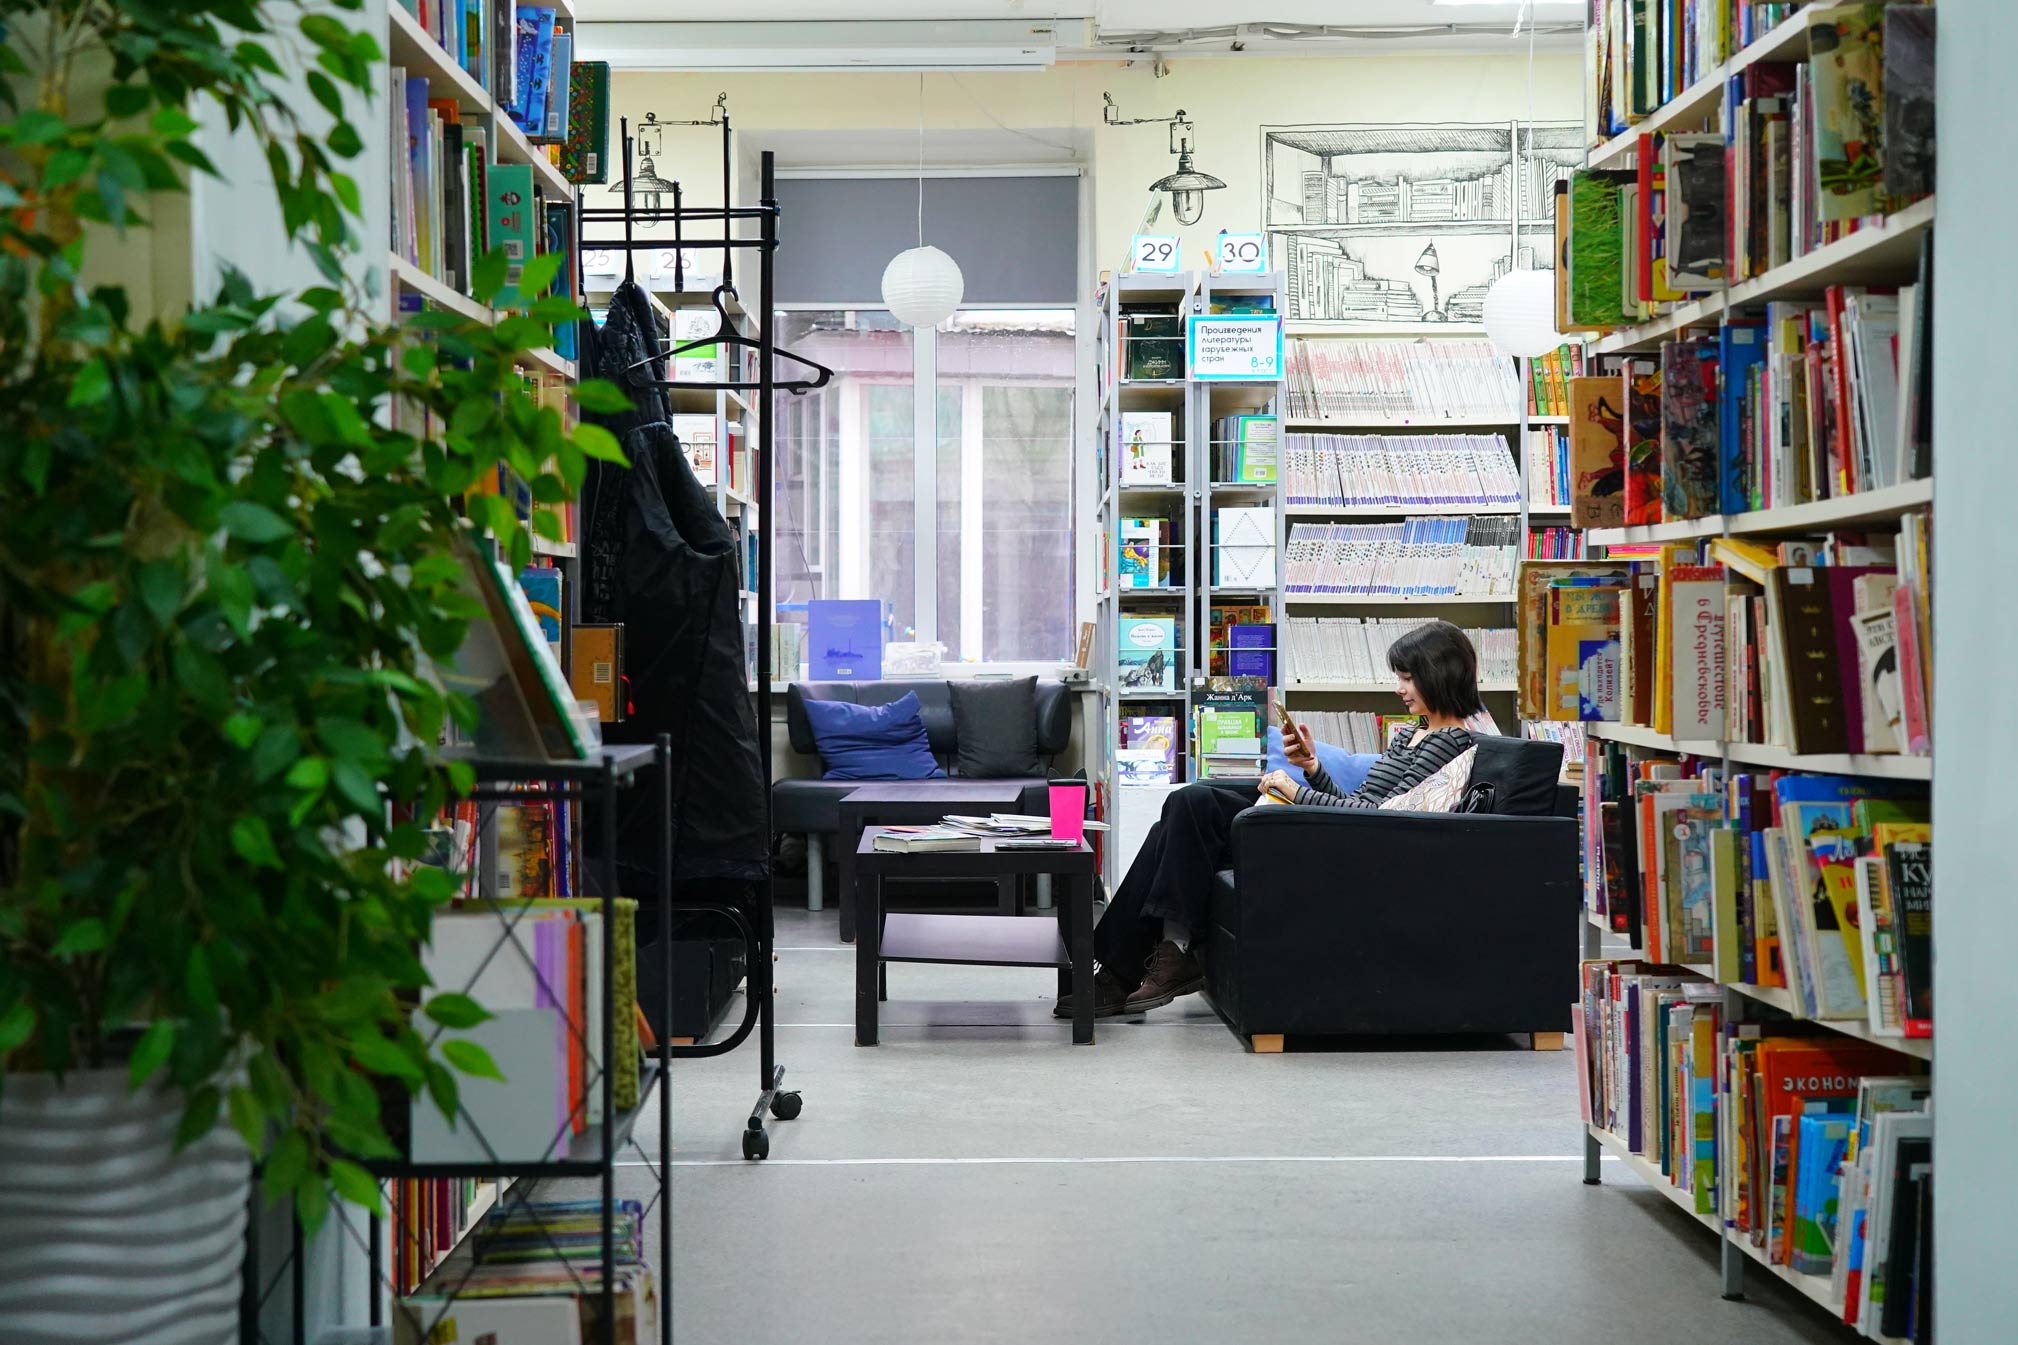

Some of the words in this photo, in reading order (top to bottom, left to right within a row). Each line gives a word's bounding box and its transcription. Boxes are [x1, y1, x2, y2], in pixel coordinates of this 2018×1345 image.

[1142, 242, 1173, 262] 29
[1223, 241, 1260, 263] 30
[583, 249, 610, 268] 25
[660, 251, 692, 270] 26
[1201, 325, 1262, 336] Произведения
[1201, 336, 1252, 345] литературы
[1201, 346, 1254, 354] зарубежных
[1201, 355, 1225, 365] стран
[1250, 356, 1274, 368] 8-9
[1206, 693, 1230, 701] Жанна
[1231, 693, 1253, 702] д'Арк
[1134, 721, 1173, 734] Анна
